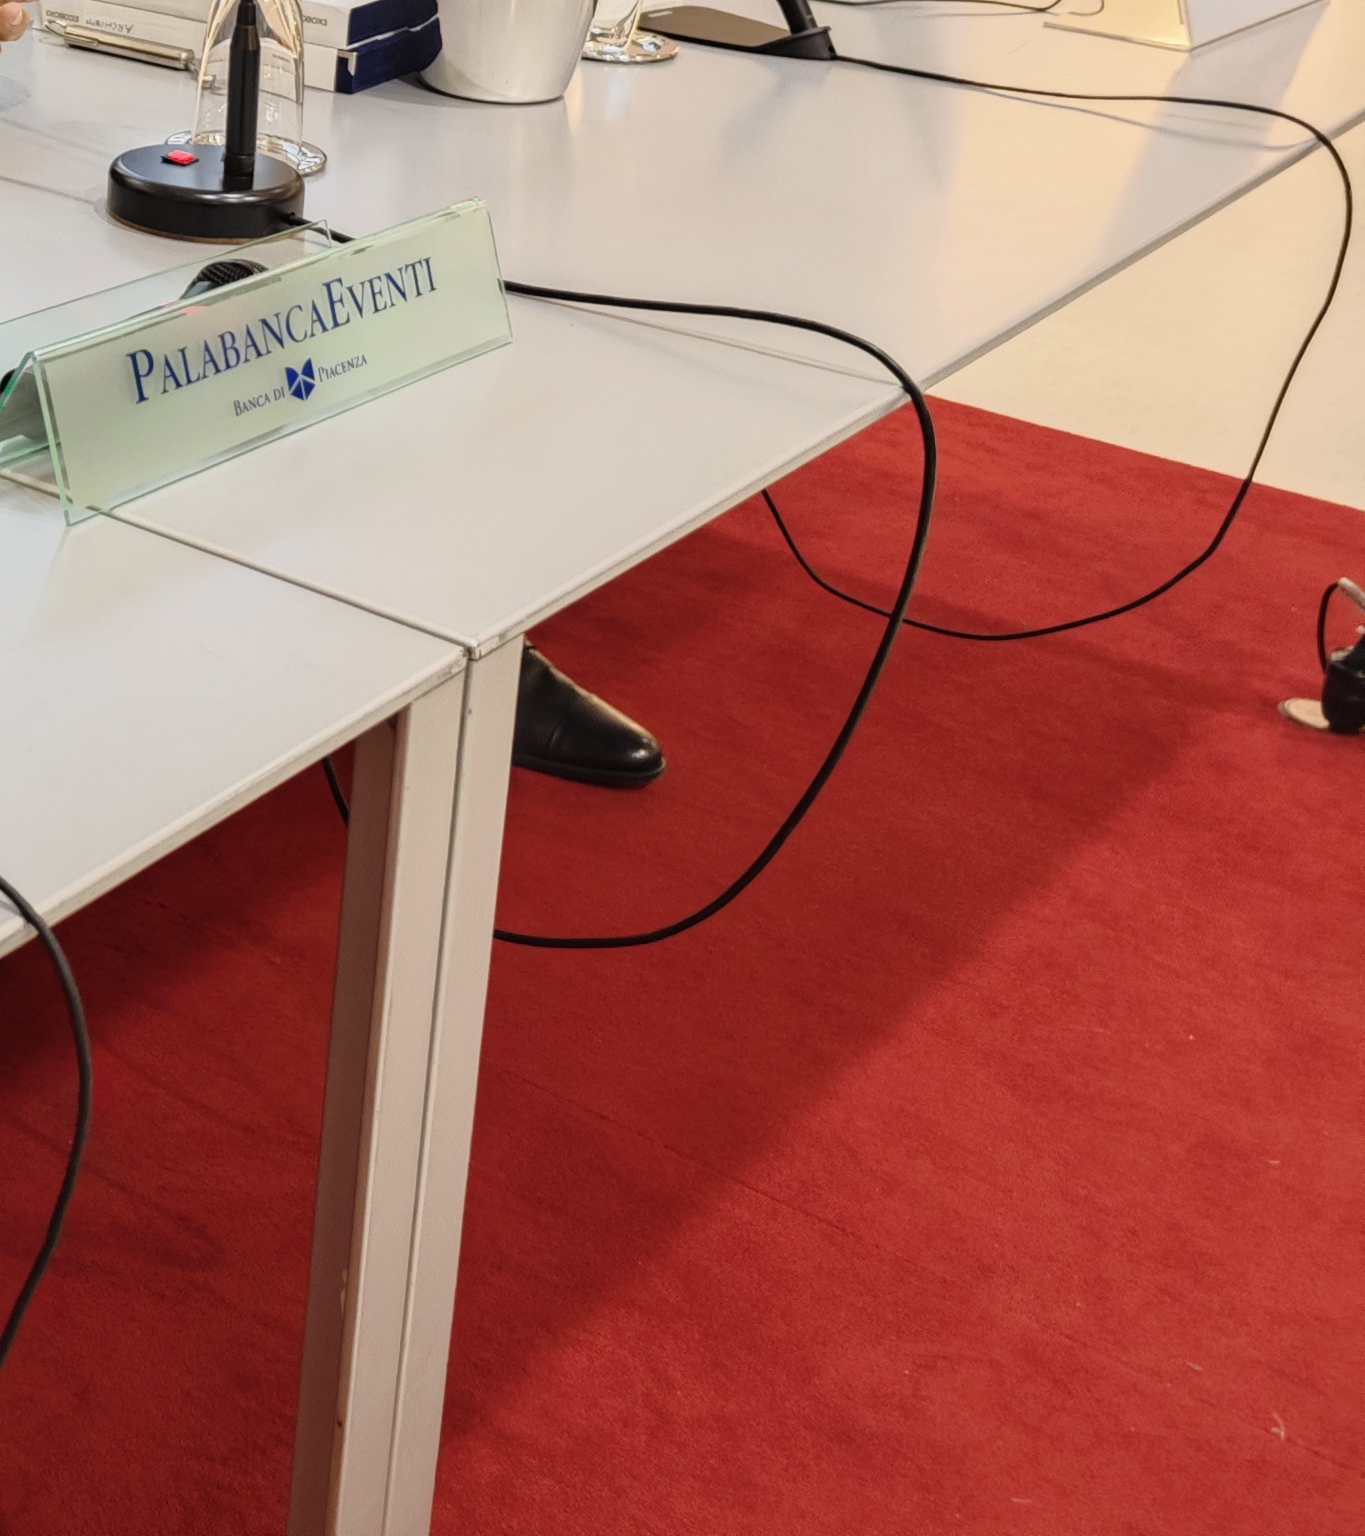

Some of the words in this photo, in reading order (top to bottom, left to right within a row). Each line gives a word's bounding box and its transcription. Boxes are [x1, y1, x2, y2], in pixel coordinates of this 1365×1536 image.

[232, 393, 271, 418] BANCA
[272, 384, 286, 404] DI
[317, 352, 369, 384] PIACENZA
